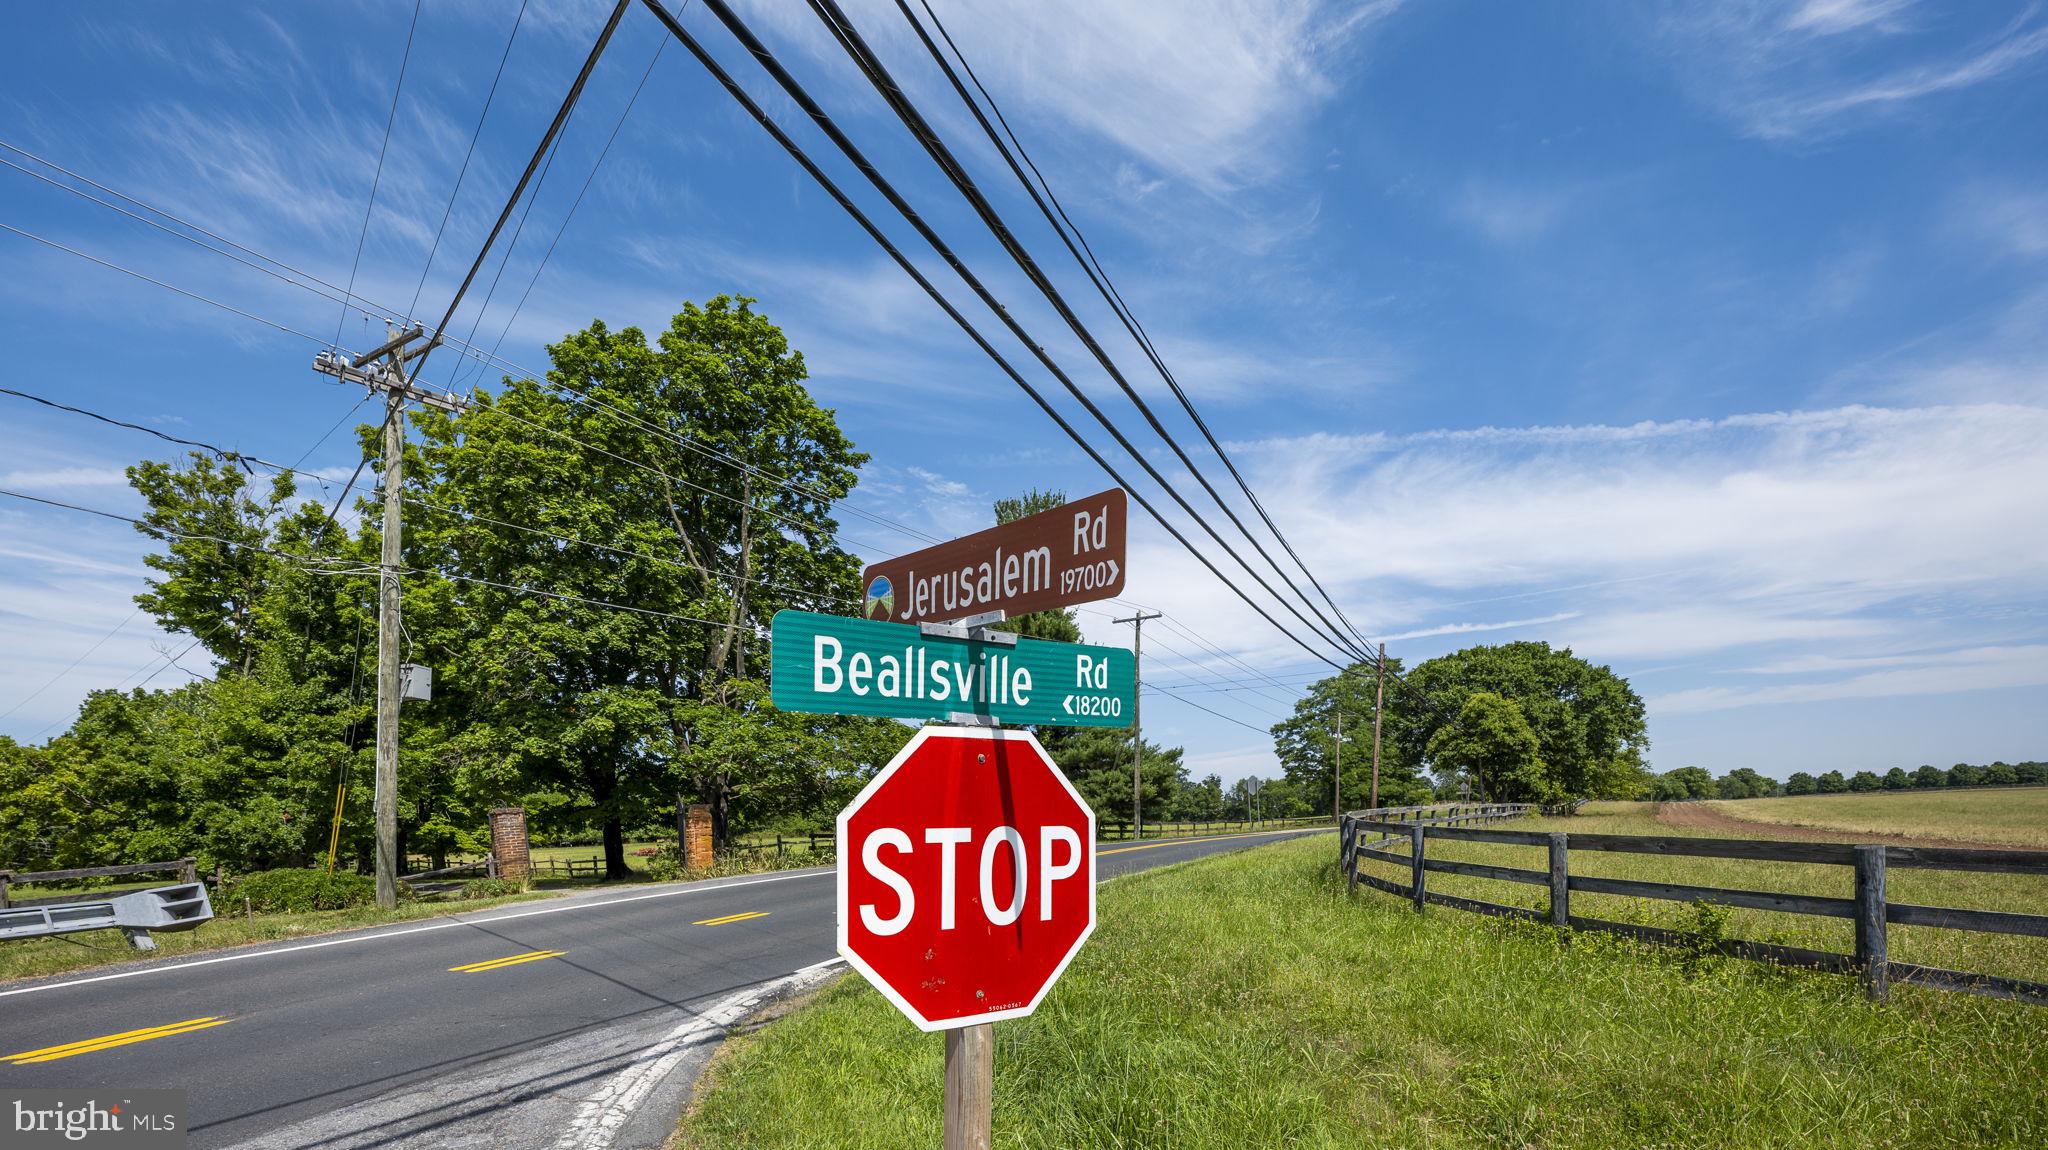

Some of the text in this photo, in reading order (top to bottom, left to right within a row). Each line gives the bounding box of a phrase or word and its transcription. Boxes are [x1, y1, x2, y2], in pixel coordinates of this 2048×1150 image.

[901, 505, 1108, 620] Jerusalem Rd
[1060, 563, 1105, 595] 19700
[814, 635, 1108, 706] Beallsville Rd
[1075, 695, 1121, 717] 18200
[859, 825, 1082, 936] STOP
